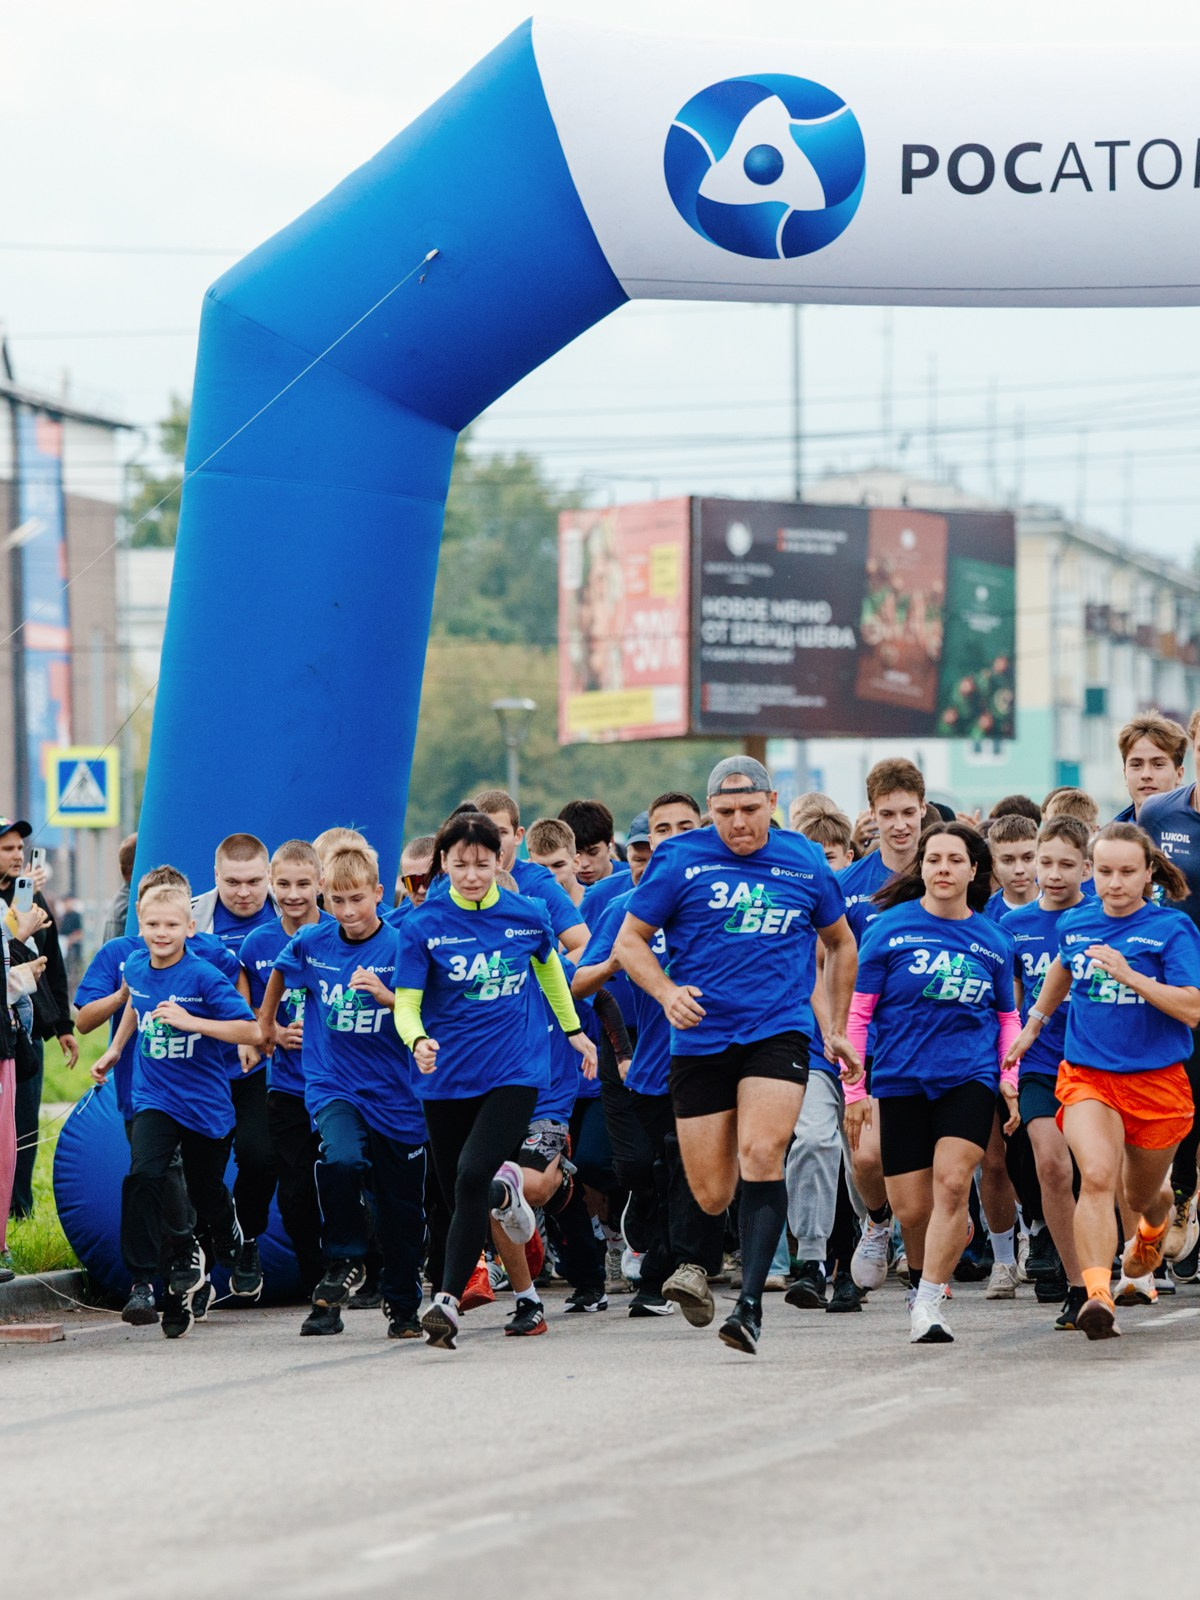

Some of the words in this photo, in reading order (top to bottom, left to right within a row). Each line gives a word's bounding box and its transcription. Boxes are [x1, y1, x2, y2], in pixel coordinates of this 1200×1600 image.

[1161, 832, 1191, 843] LUKOIL
[780, 869, 814, 880] РОСАТОМ
[708, 881, 764, 909] ЗА!
[738, 908, 801, 934] БЕГ
[1134, 937, 1164, 947] РОСАТОМ
[448, 950, 501, 981] ЗА!
[908, 949, 965, 976] ЗА!
[938, 977, 992, 1004] БЕГ
[337, 1008, 391, 1033] БЕГ
[150, 1033, 201, 1059] БЕГ
